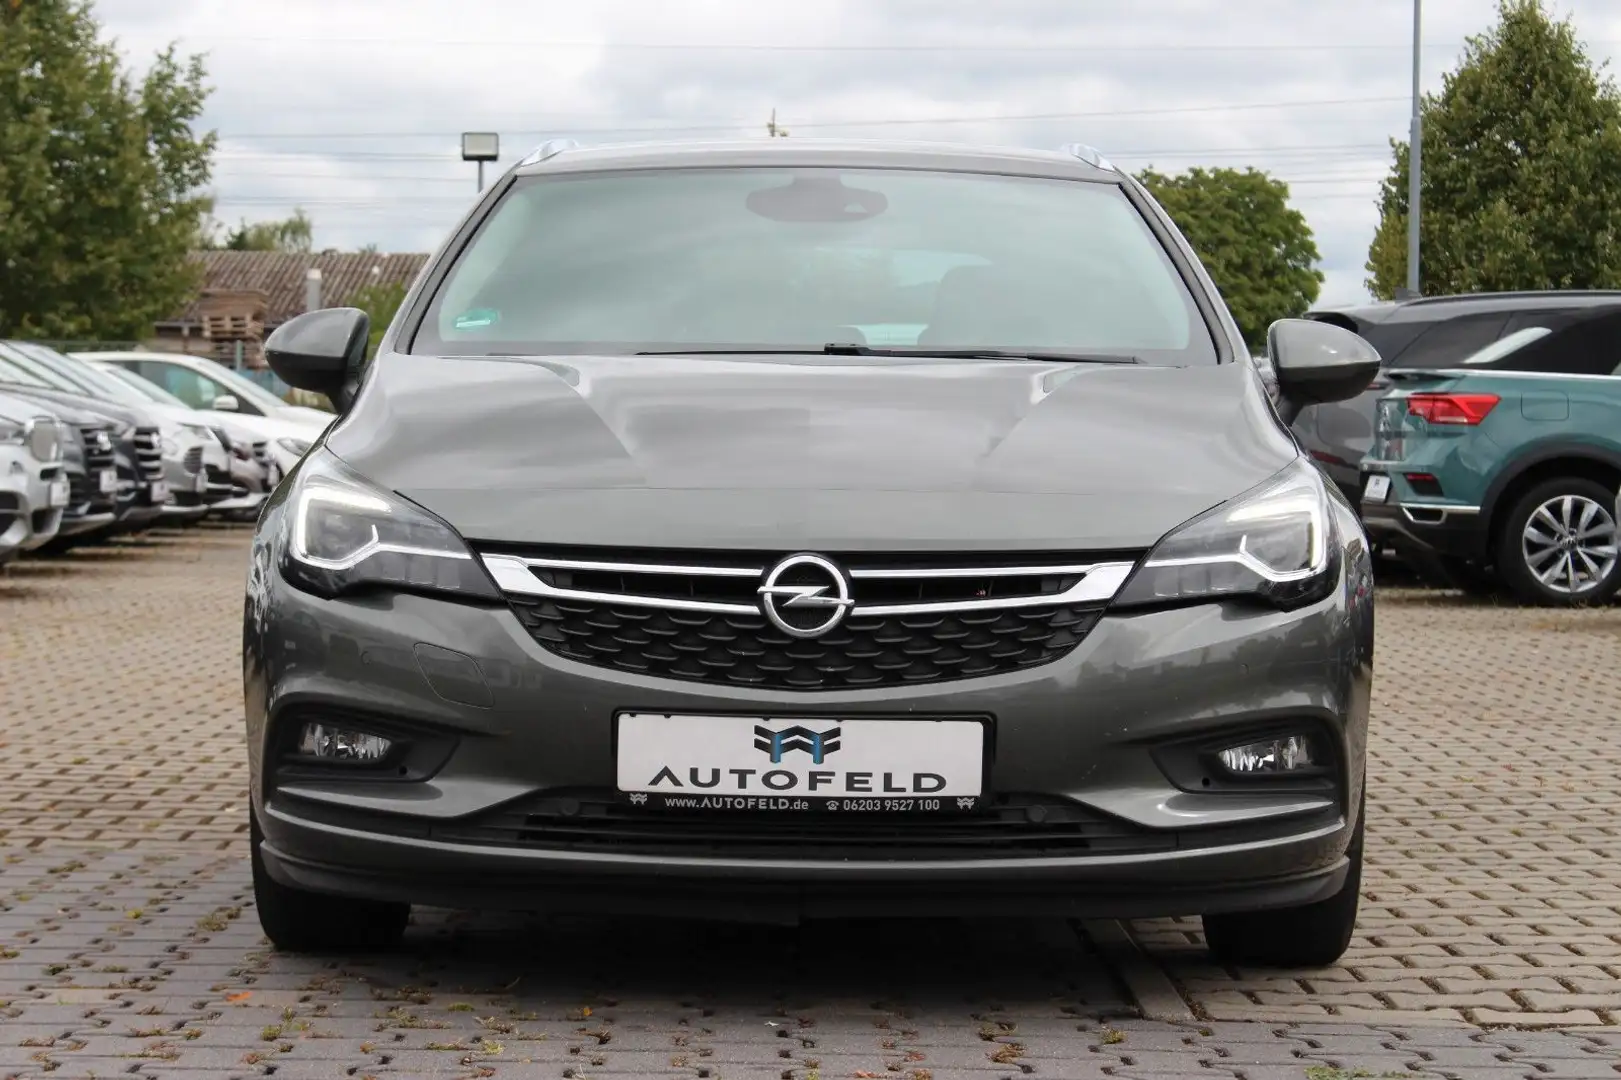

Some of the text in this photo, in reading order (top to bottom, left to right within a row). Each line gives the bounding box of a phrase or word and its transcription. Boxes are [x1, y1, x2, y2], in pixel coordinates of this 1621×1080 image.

[648, 765, 947, 793] AUTOFELD
[665, 798, 809, 811] www.AUTOFELD.de
[843, 799, 940, 811] 06203 9527 100
